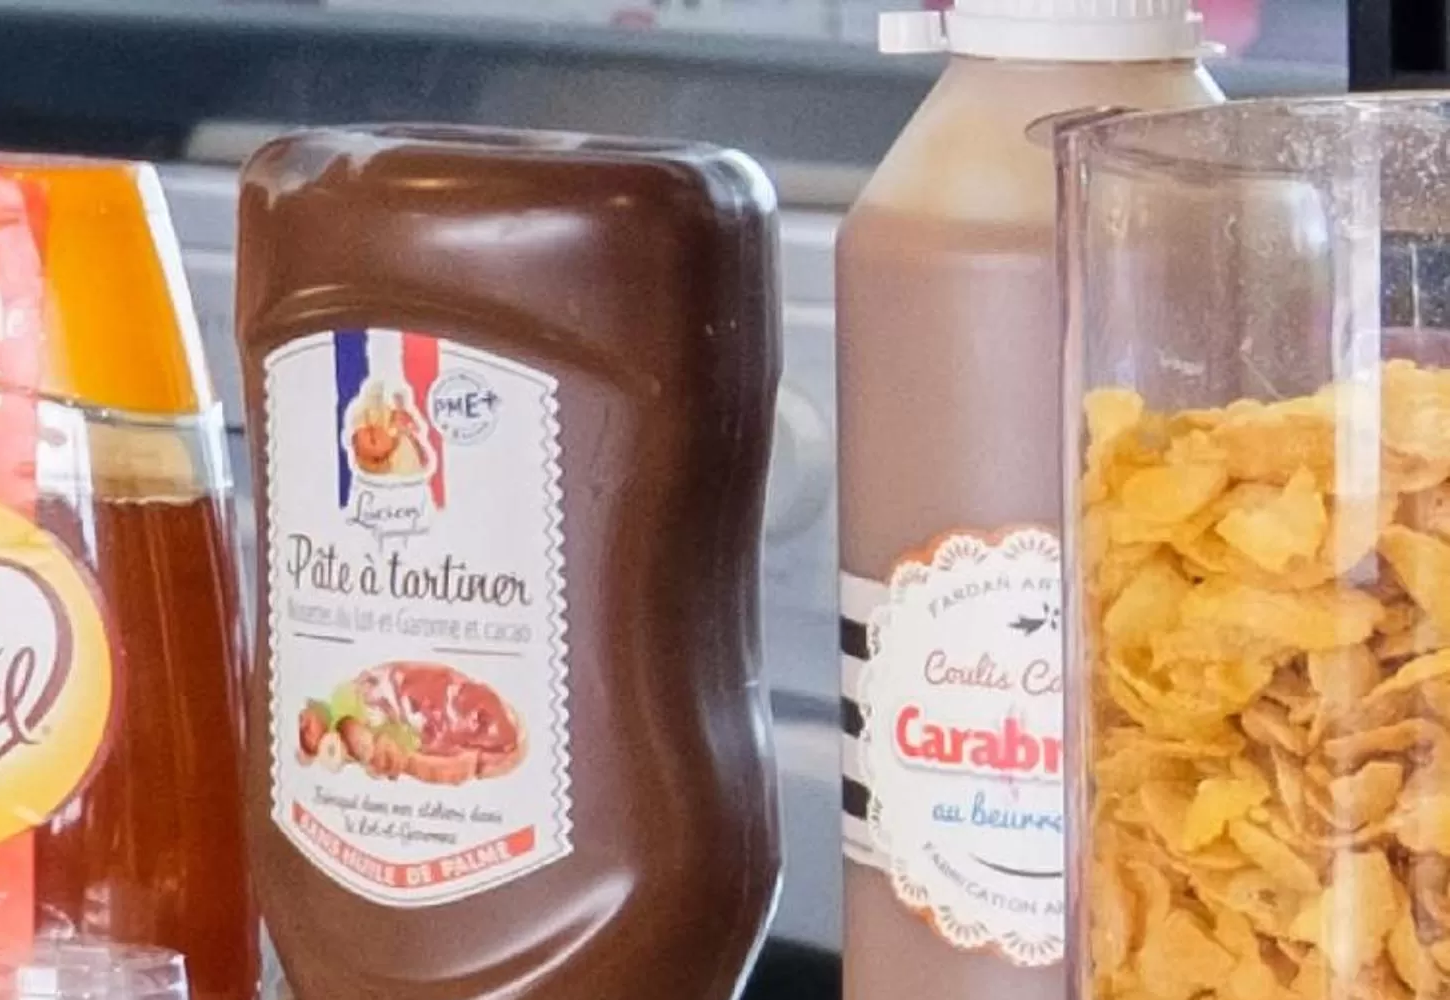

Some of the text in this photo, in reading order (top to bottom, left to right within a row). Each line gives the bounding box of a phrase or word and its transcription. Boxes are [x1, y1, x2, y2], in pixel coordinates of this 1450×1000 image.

[287, 533, 532, 606] Pâte à tartiner
[924, 649, 1014, 690] Coulis
[932, 803, 967, 823] au
